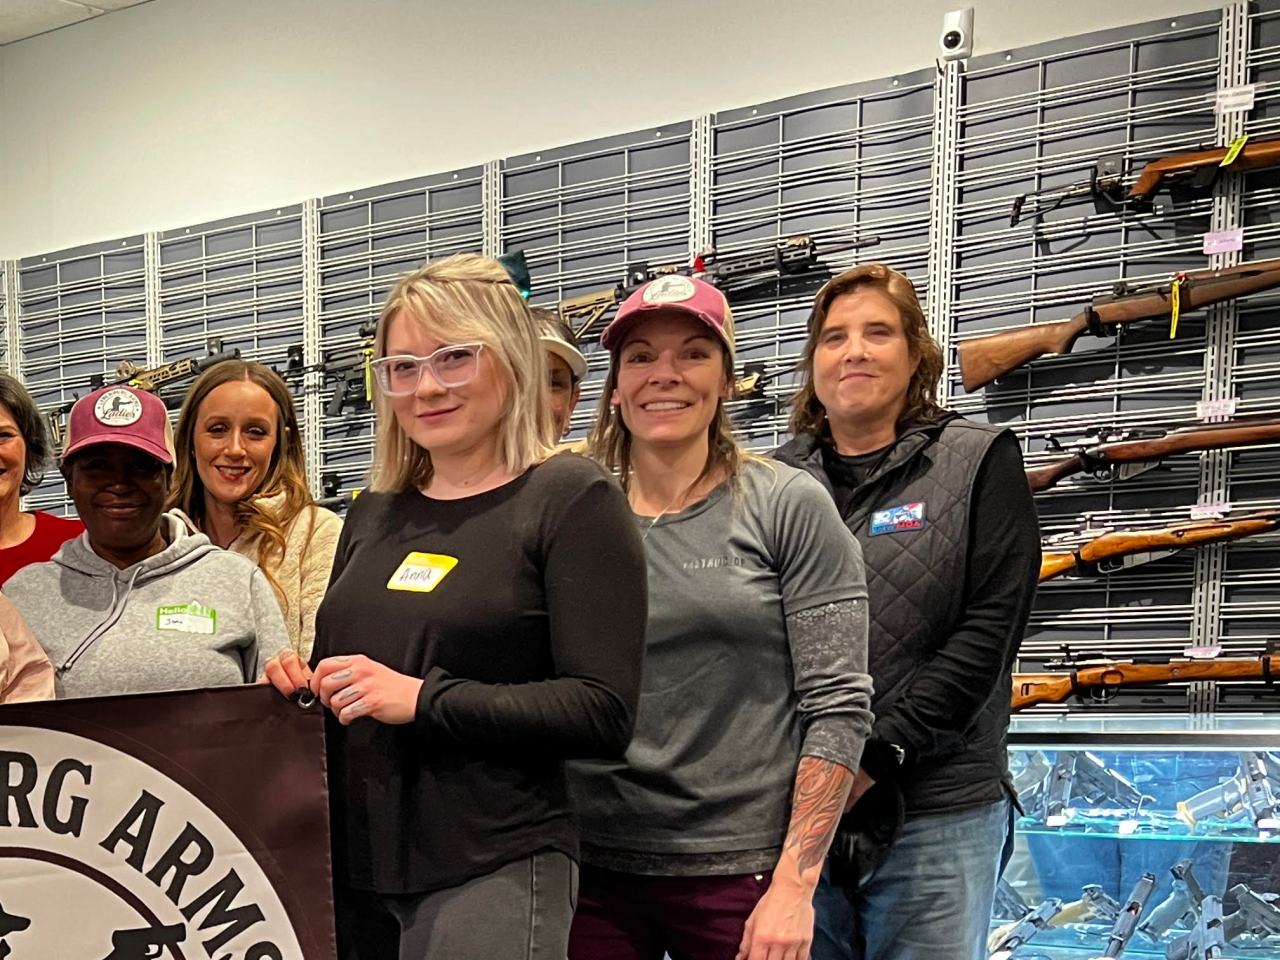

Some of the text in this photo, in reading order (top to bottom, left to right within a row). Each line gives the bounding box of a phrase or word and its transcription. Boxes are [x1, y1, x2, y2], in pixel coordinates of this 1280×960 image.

[100, 408, 136, 421] Ladies
[400, 567, 432, 581] Anna
[159, 607, 187, 615] Hello
